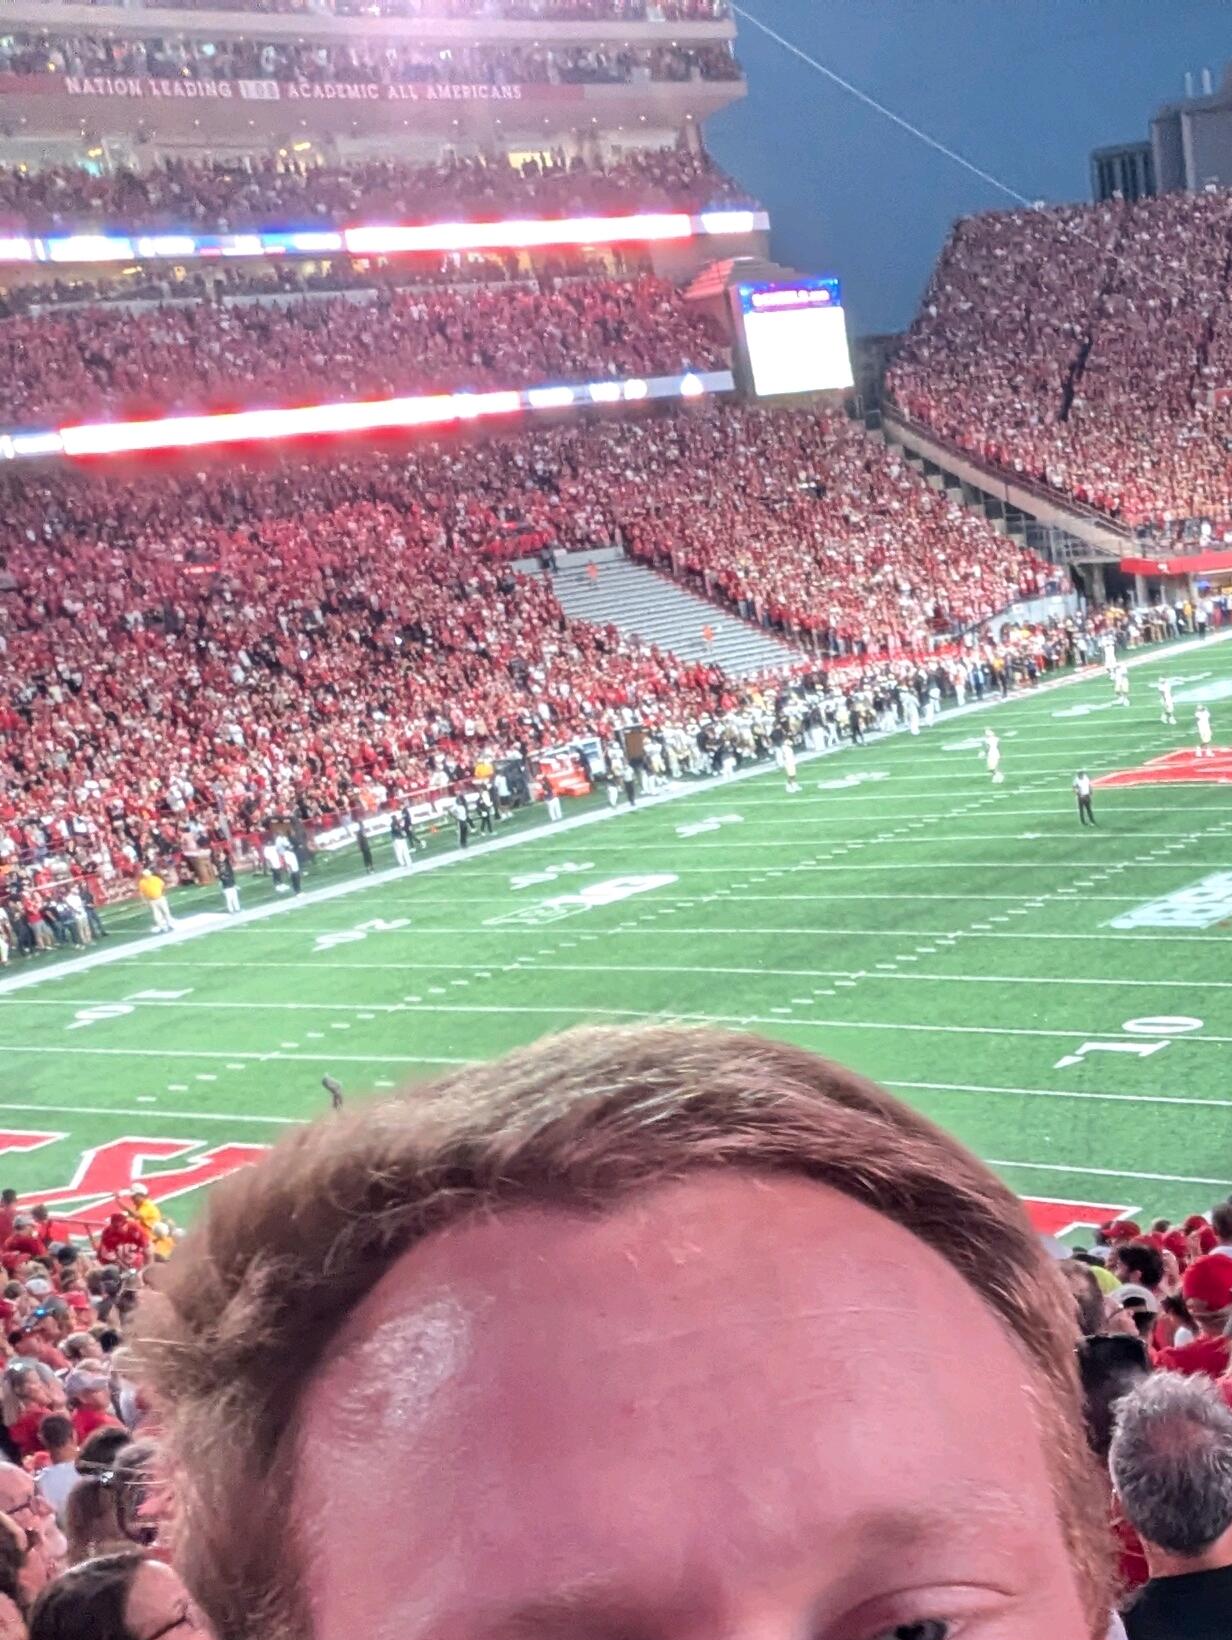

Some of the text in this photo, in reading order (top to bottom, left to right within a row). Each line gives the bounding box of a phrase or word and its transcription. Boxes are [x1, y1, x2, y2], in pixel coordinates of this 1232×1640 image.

[64, 77, 142, 97] NATION
[148, 78, 233, 98] LEADING
[287, 83, 379, 99] ACADEMIC
[388, 84, 418, 100] ALL
[426, 84, 522, 100] AMERICANS
[1075, 1015, 1204, 1057] 10
